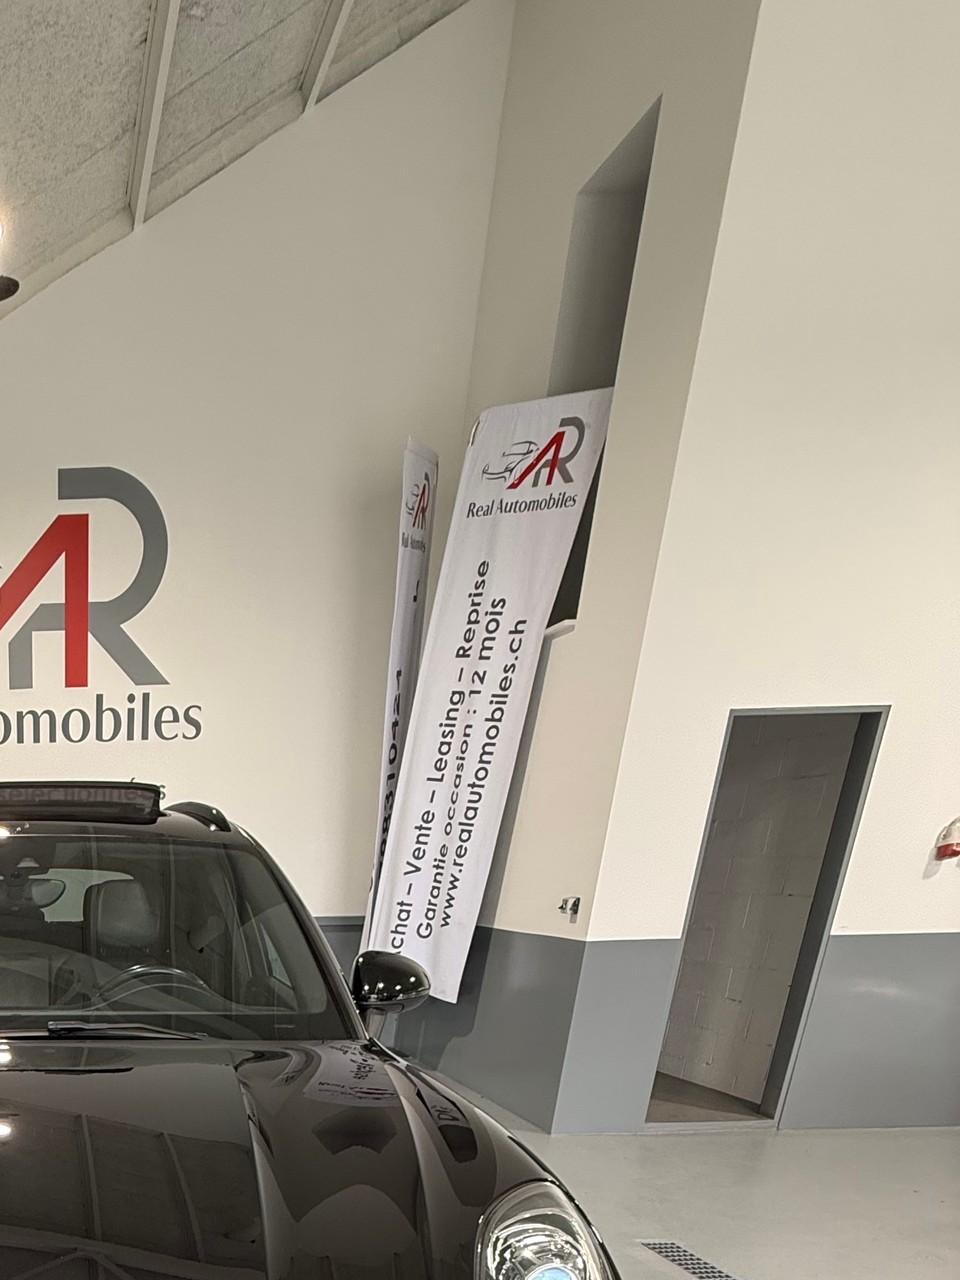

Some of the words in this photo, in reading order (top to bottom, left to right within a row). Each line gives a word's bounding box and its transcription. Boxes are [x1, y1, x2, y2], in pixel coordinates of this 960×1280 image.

[466, 500, 495, 519] Real
[495, 492, 578, 515] Automobiles
[390, 900, 413, 955] chat
[403, 809, 436, 876] Vente
[426, 690, 466, 783] Leasing
[455, 560, 489, 659] Reprise
[416, 843, 449, 940] Garantie
[444, 723, 474, 837] occasion
[468, 670, 488, 699] 12
[478, 597, 507, 661] mois
[440, 618, 528, 929] www.realautomobiles.ch
